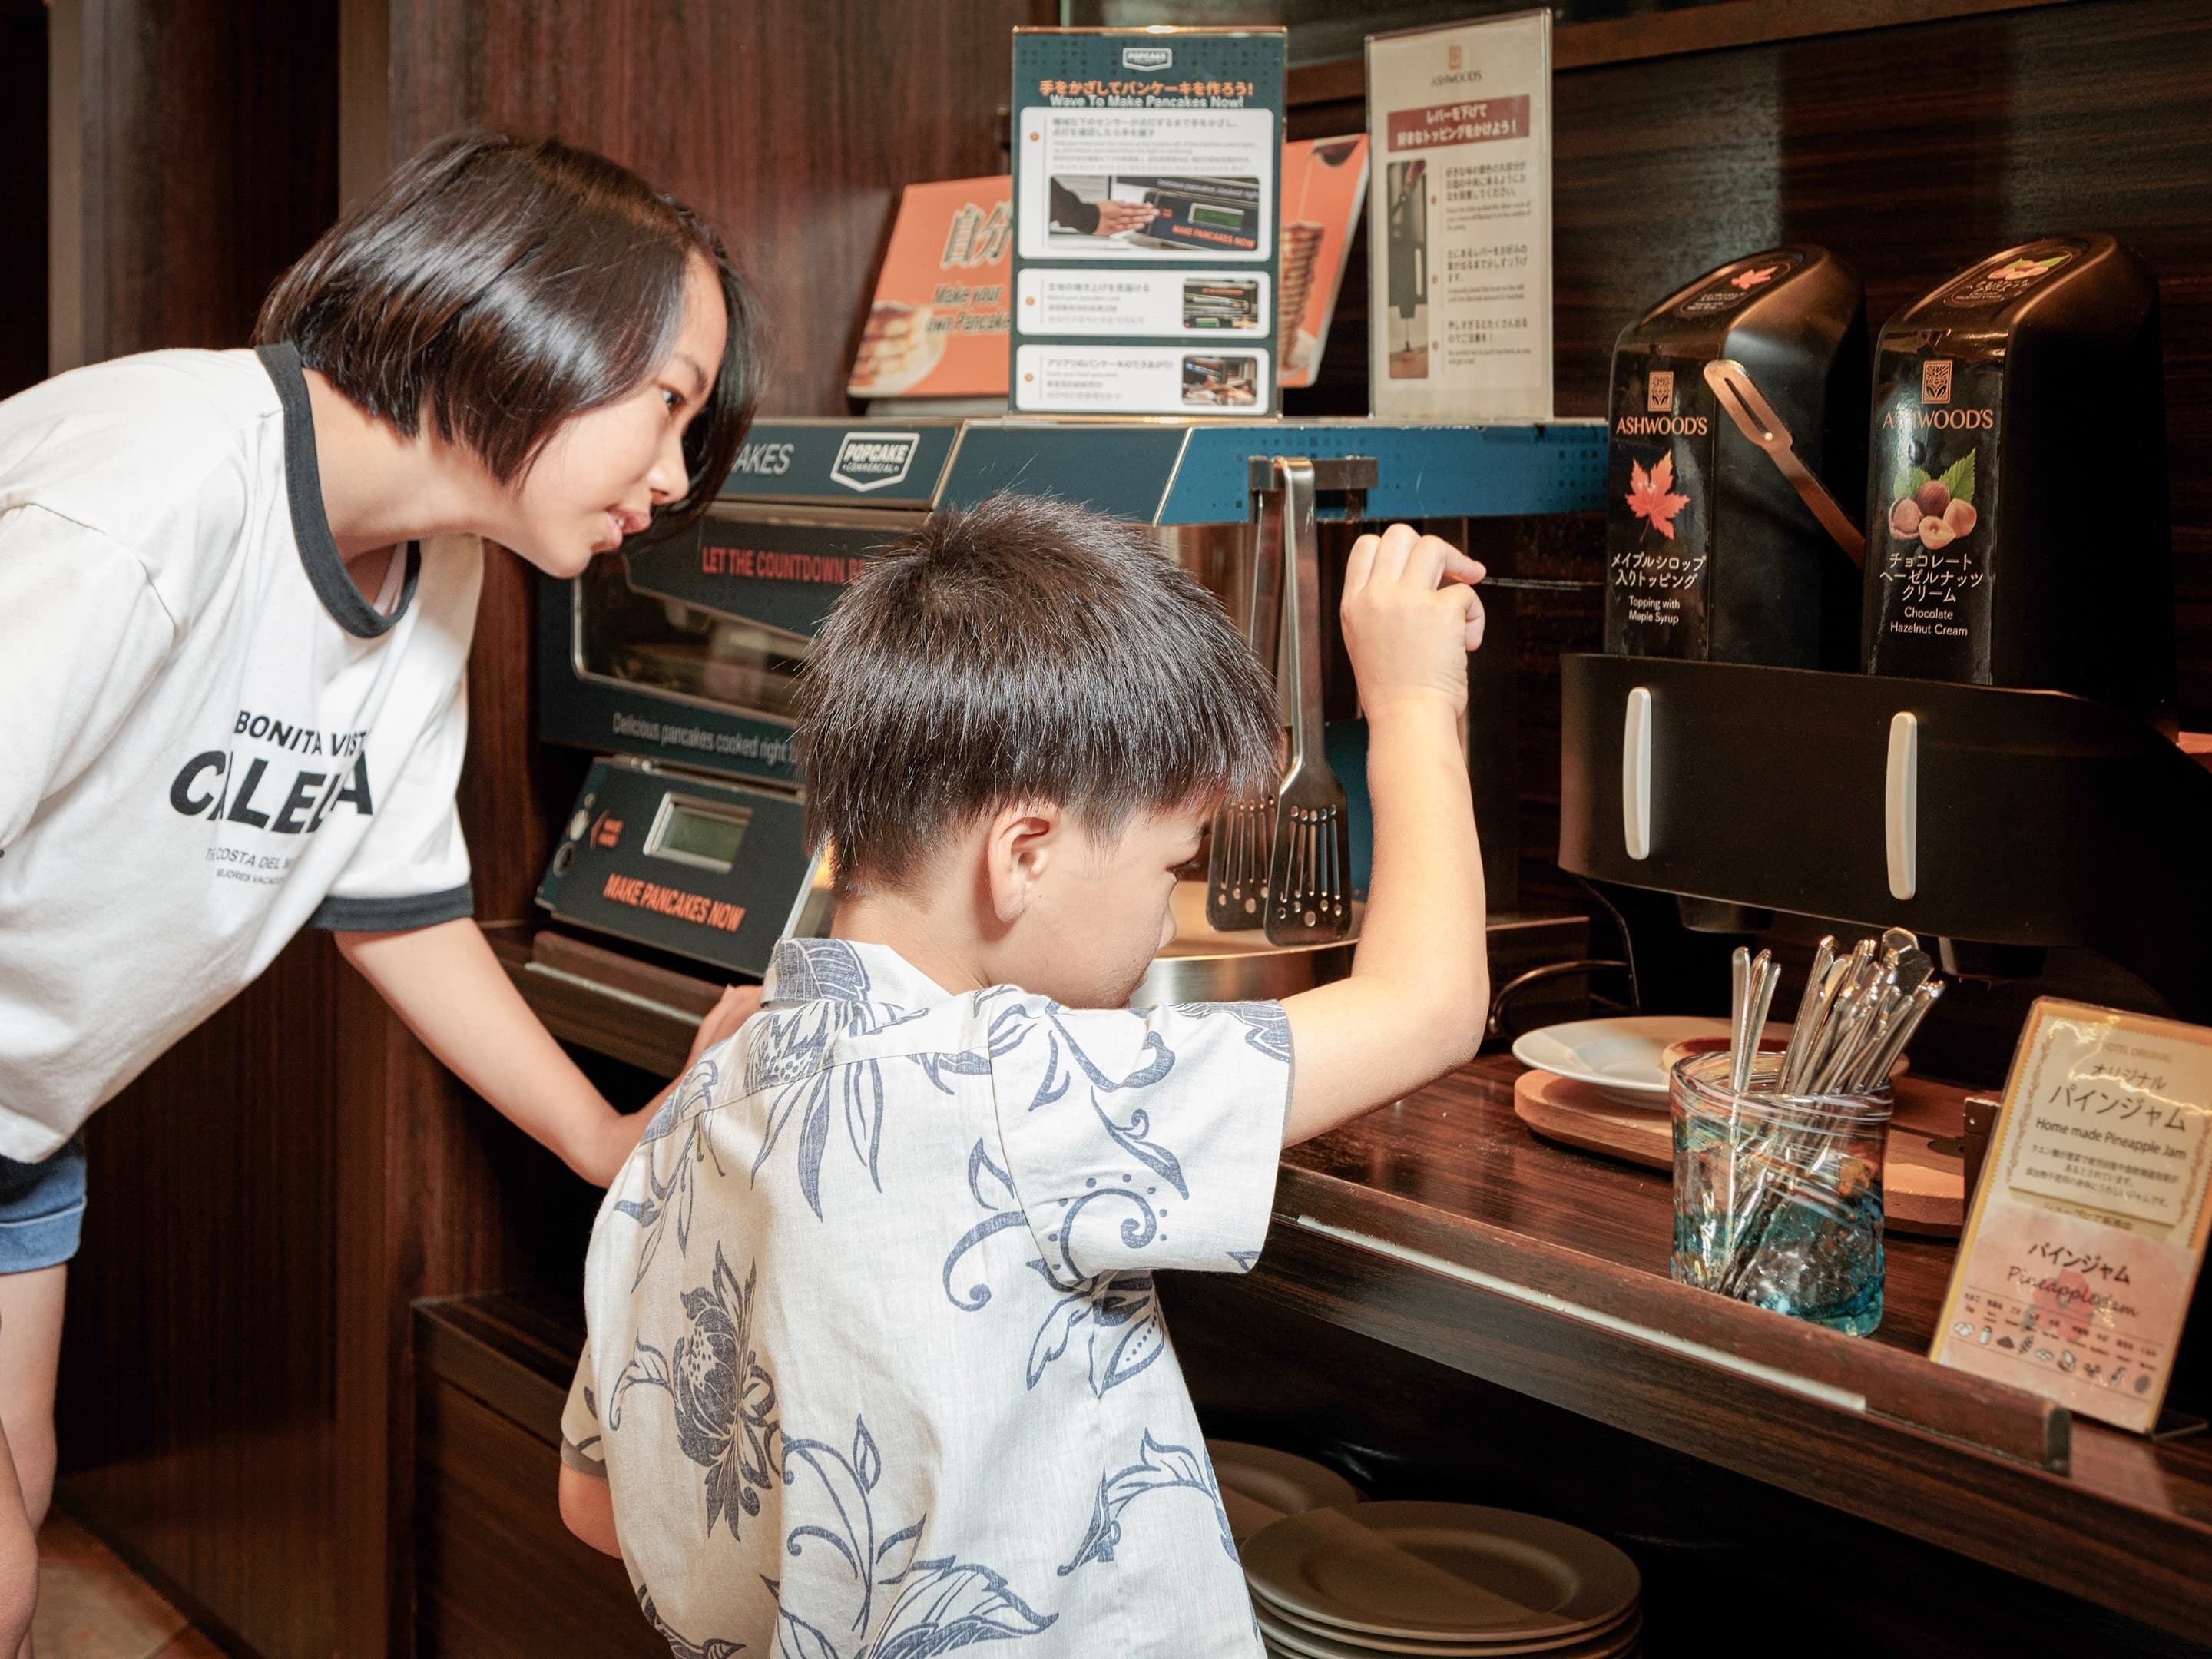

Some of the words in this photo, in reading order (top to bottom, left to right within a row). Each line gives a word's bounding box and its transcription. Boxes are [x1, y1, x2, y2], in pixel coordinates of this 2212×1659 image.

[1050, 94, 1086, 108] Wave
[1088, 94, 1105, 107] To
[1108, 94, 1144, 108] Make
[1146, 94, 1208, 108] Pancakes
[1194, 227, 1233, 246] PANCAKES
[1234, 235, 1256, 250] NOW
[934, 283, 970, 305] Make
[970, 285, 1004, 310] your
[1615, 416, 1708, 435] ASHWOOD'S
[843, 443, 910, 464] POPCAKE
[702, 546, 727, 575] LET
[729, 548, 754, 576] THE
[756, 552, 846, 585] COUNTDOWN
[1611, 551, 1707, 572] メイプルシロップ
[1889, 552, 1972, 571] チョコレート
[1615, 568, 1699, 590] 入りトッピング
[1879, 568, 1984, 588] ヘーゼルナッツ
[1628, 595, 1661, 611] Topping
[1662, 598, 1681, 609] with
[1902, 584, 1957, 603] クリーム
[1628, 609, 1654, 624] Maple
[1655, 611, 1680, 627] Syrup
[1904, 605, 1954, 620] Chocolate
[1890, 621, 1932, 634] Hazelnut
[1934, 623, 1969, 637] Cream
[233, 710, 323, 757] BONITA
[613, 712, 661, 738] Delicious
[661, 724, 714, 750] pancakes
[716, 733, 759, 758] cooked
[760, 740, 788, 767] right
[603, 873, 643, 906] MAKE
[640, 881, 711, 922] PANCAKES
[707, 900, 747, 932] NOW
[2092, 1063, 2167, 1091] オリジナル
[2048, 1083, 2186, 1132] パインジャム
[2036, 1117, 2070, 1137] Home
[2071, 1126, 2104, 1145] made
[2103, 1131, 2161, 1156] Pineapple
[2162, 1143, 2187, 1161] Jam
[2028, 1242, 2131, 1286] パインジャム
[2007, 1265, 2100, 1307] Pineapple
